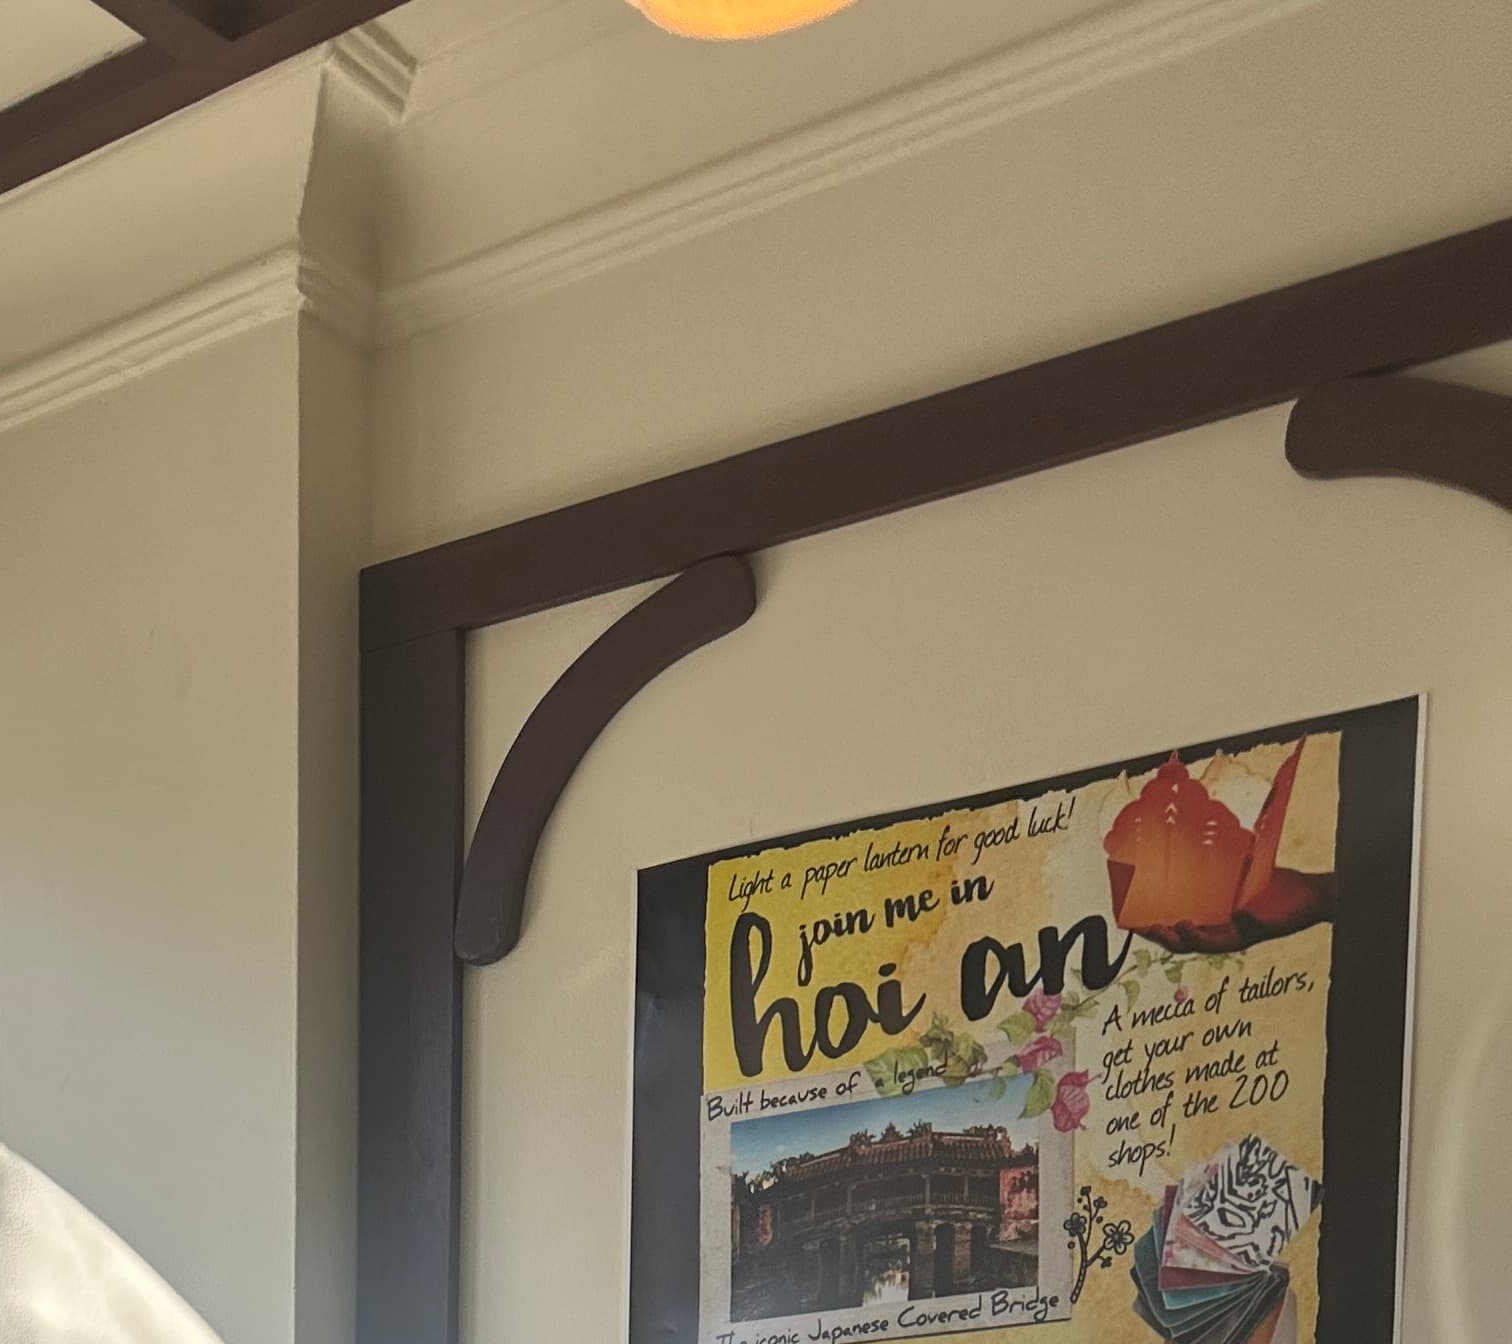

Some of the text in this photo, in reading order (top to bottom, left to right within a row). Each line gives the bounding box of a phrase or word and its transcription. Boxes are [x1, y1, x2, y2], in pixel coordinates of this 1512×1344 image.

[728, 796, 1076, 912] Light a paper lantern for good luck!
[797, 874, 995, 987] join me in
[730, 911, 1134, 1077] hoi an
[1102, 966, 1315, 1036] A mecca of tailors,
[1102, 1019, 1253, 1085] get your own
[1105, 1040, 1279, 1101] clothes made at
[707, 1053, 947, 1120] Built because of a legend
[1106, 1069, 1289, 1135] one of the 200
[1108, 1124, 1176, 1177] shops!
[897, 1294, 982, 1329] Covered
[991, 1286, 1060, 1323] Bridge
